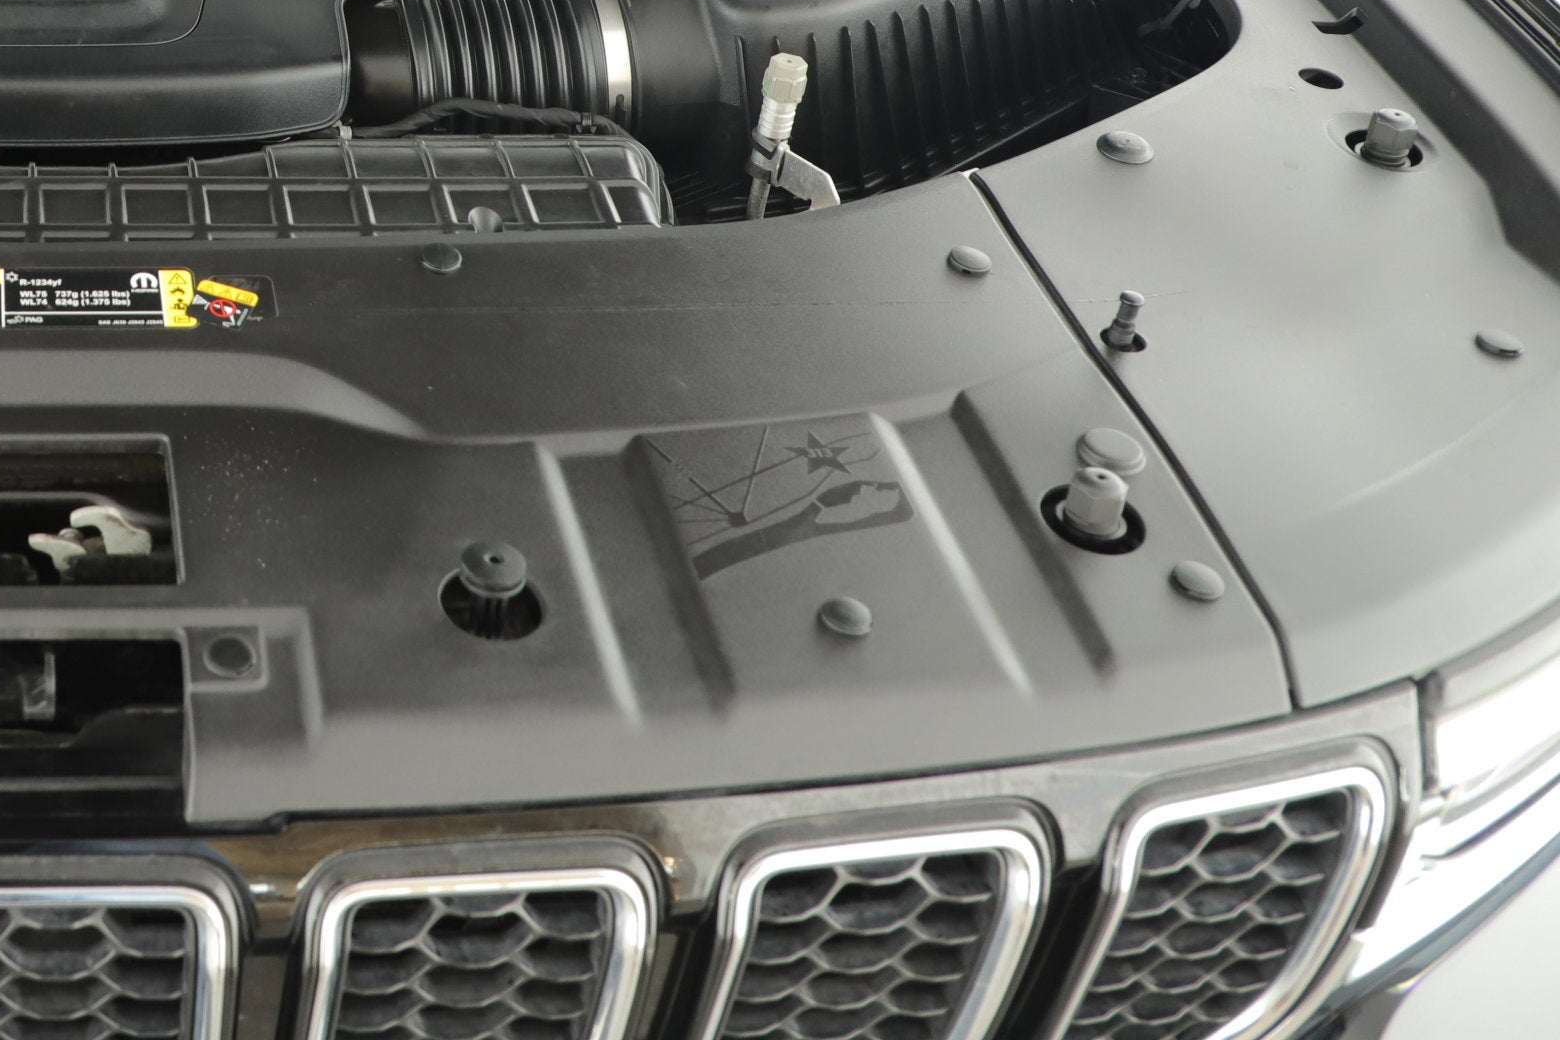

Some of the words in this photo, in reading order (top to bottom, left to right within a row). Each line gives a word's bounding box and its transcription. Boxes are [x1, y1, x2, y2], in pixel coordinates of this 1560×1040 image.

[19, 279, 62, 287] R-1234yf
[55, 291, 79, 299] 737g
[80, 290, 110, 298] (1.625
[111, 290, 130, 298] lbs)
[55, 299, 79, 307] 624g
[80, 298, 110, 307] (1.375
[112, 298, 131, 307] lbs)
